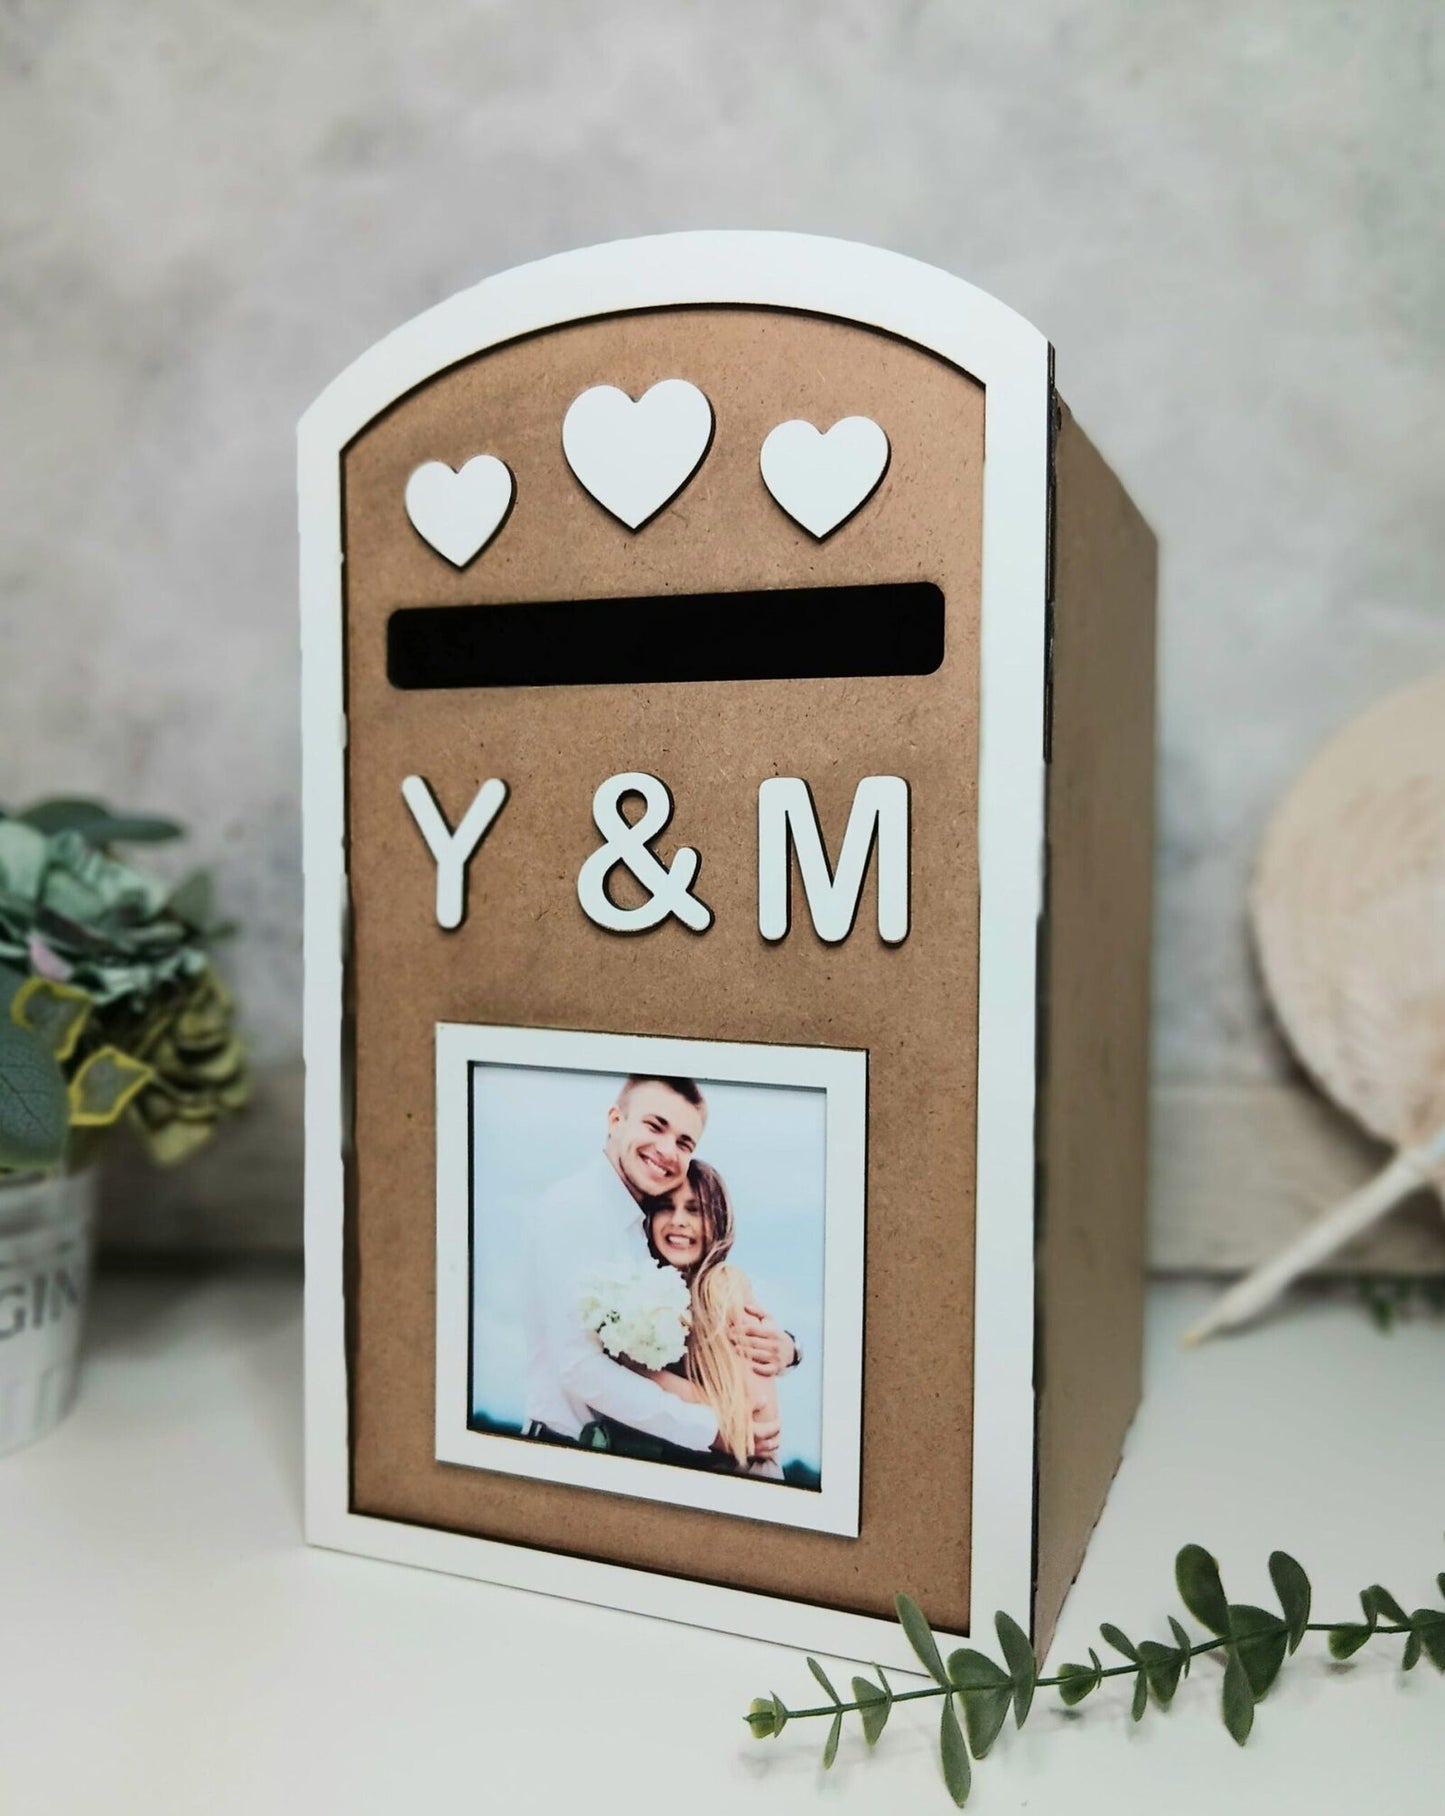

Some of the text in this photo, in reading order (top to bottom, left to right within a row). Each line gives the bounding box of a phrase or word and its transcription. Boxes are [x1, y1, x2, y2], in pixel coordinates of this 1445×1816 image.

[401, 771, 912, 945] Y & M
